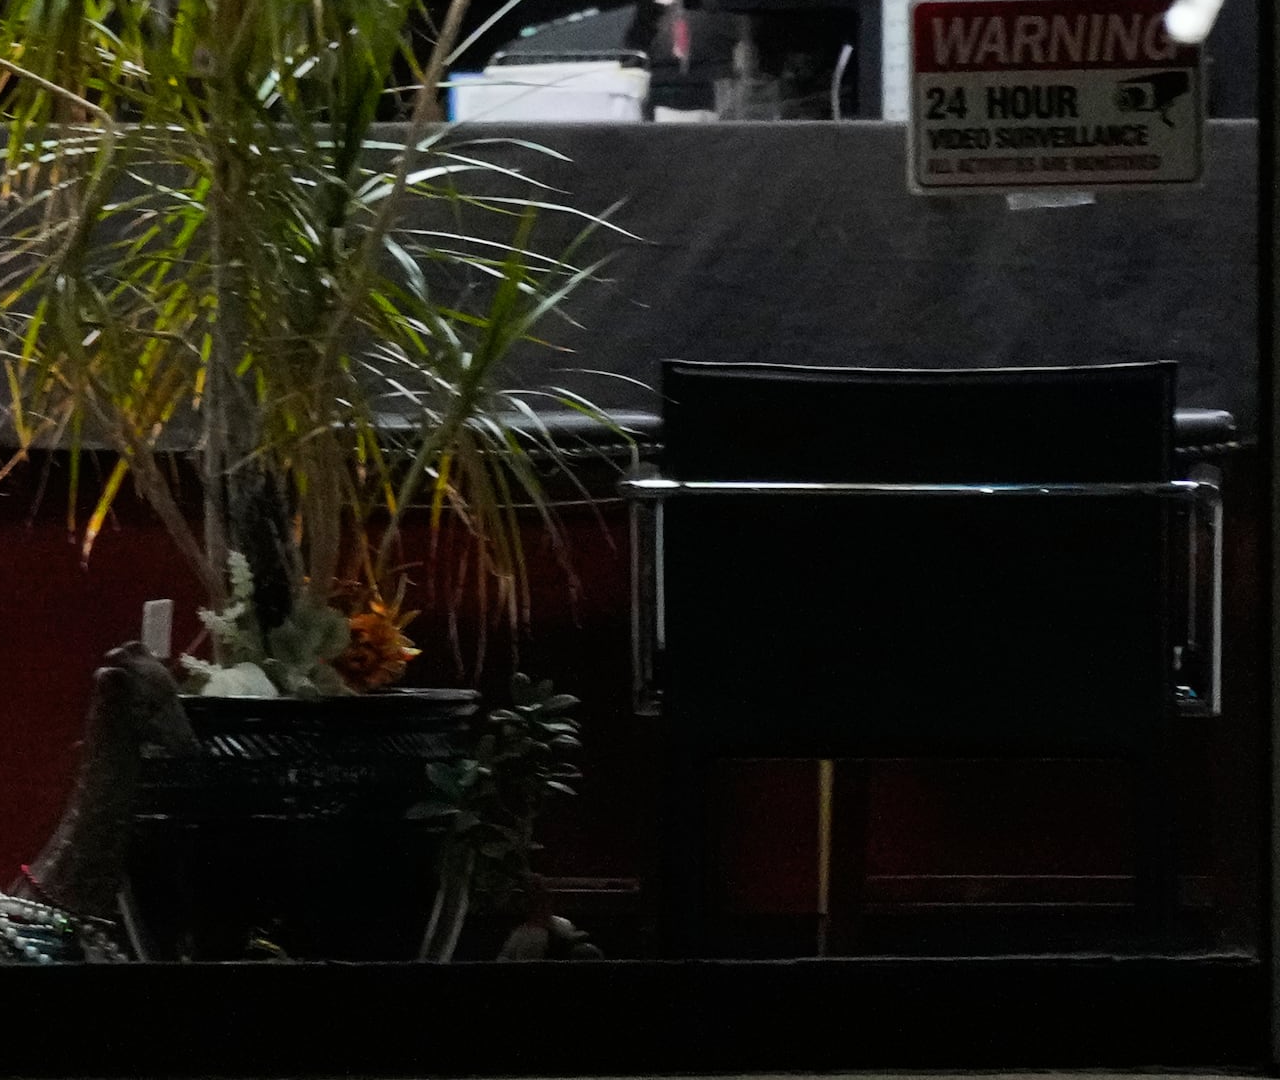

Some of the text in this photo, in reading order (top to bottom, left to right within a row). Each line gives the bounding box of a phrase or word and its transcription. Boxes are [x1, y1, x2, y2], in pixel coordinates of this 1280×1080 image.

[931, 12, 1179, 66] WARNING
[926, 84, 1080, 121] 24 HOUR
[926, 124, 1149, 149] VIDEO SURVEILLANCE
